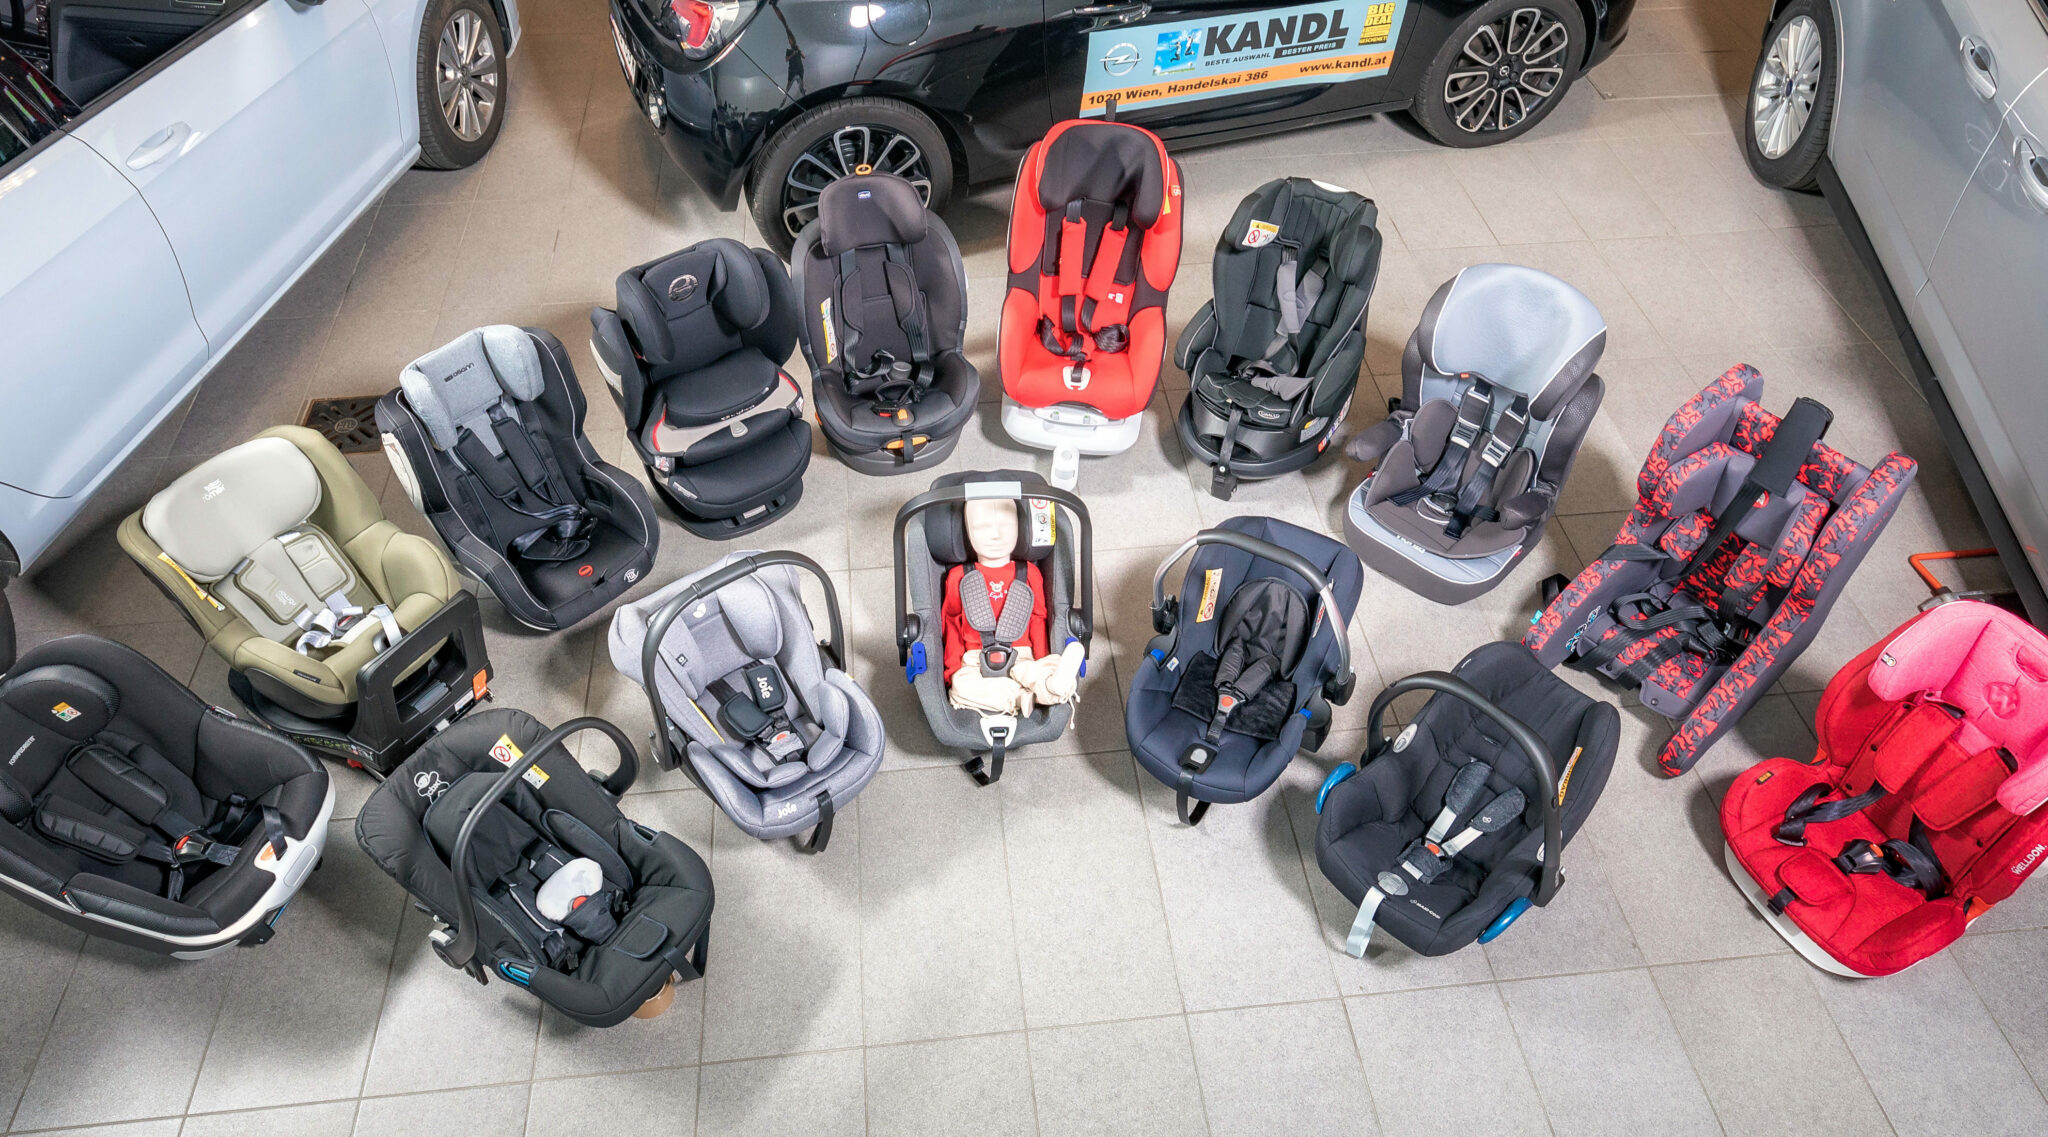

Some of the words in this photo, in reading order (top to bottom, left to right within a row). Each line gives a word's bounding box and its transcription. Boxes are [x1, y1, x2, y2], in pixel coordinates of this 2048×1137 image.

[1367, 2, 1396, 15] BIG
[1364, 15, 1392, 27] DEAL
[1204, 9, 1349, 57] KANDL
[1282, 45, 1312, 56] BESTER
[1314, 42, 1337, 51] PREIS
[1205, 58, 1230, 67] BESTE
[1233, 53, 1271, 63] AUSWAHL
[1300, 56, 1387, 73] www.kandl.at
[1089, 92, 1121, 105] 1020
[1126, 89, 1163, 100] Wien,
[1167, 75, 1242, 94] Handelskai
[1245, 70, 1269, 82] 386
[757, 676, 774, 700] Joie
[777, 802, 798, 819] Joie
